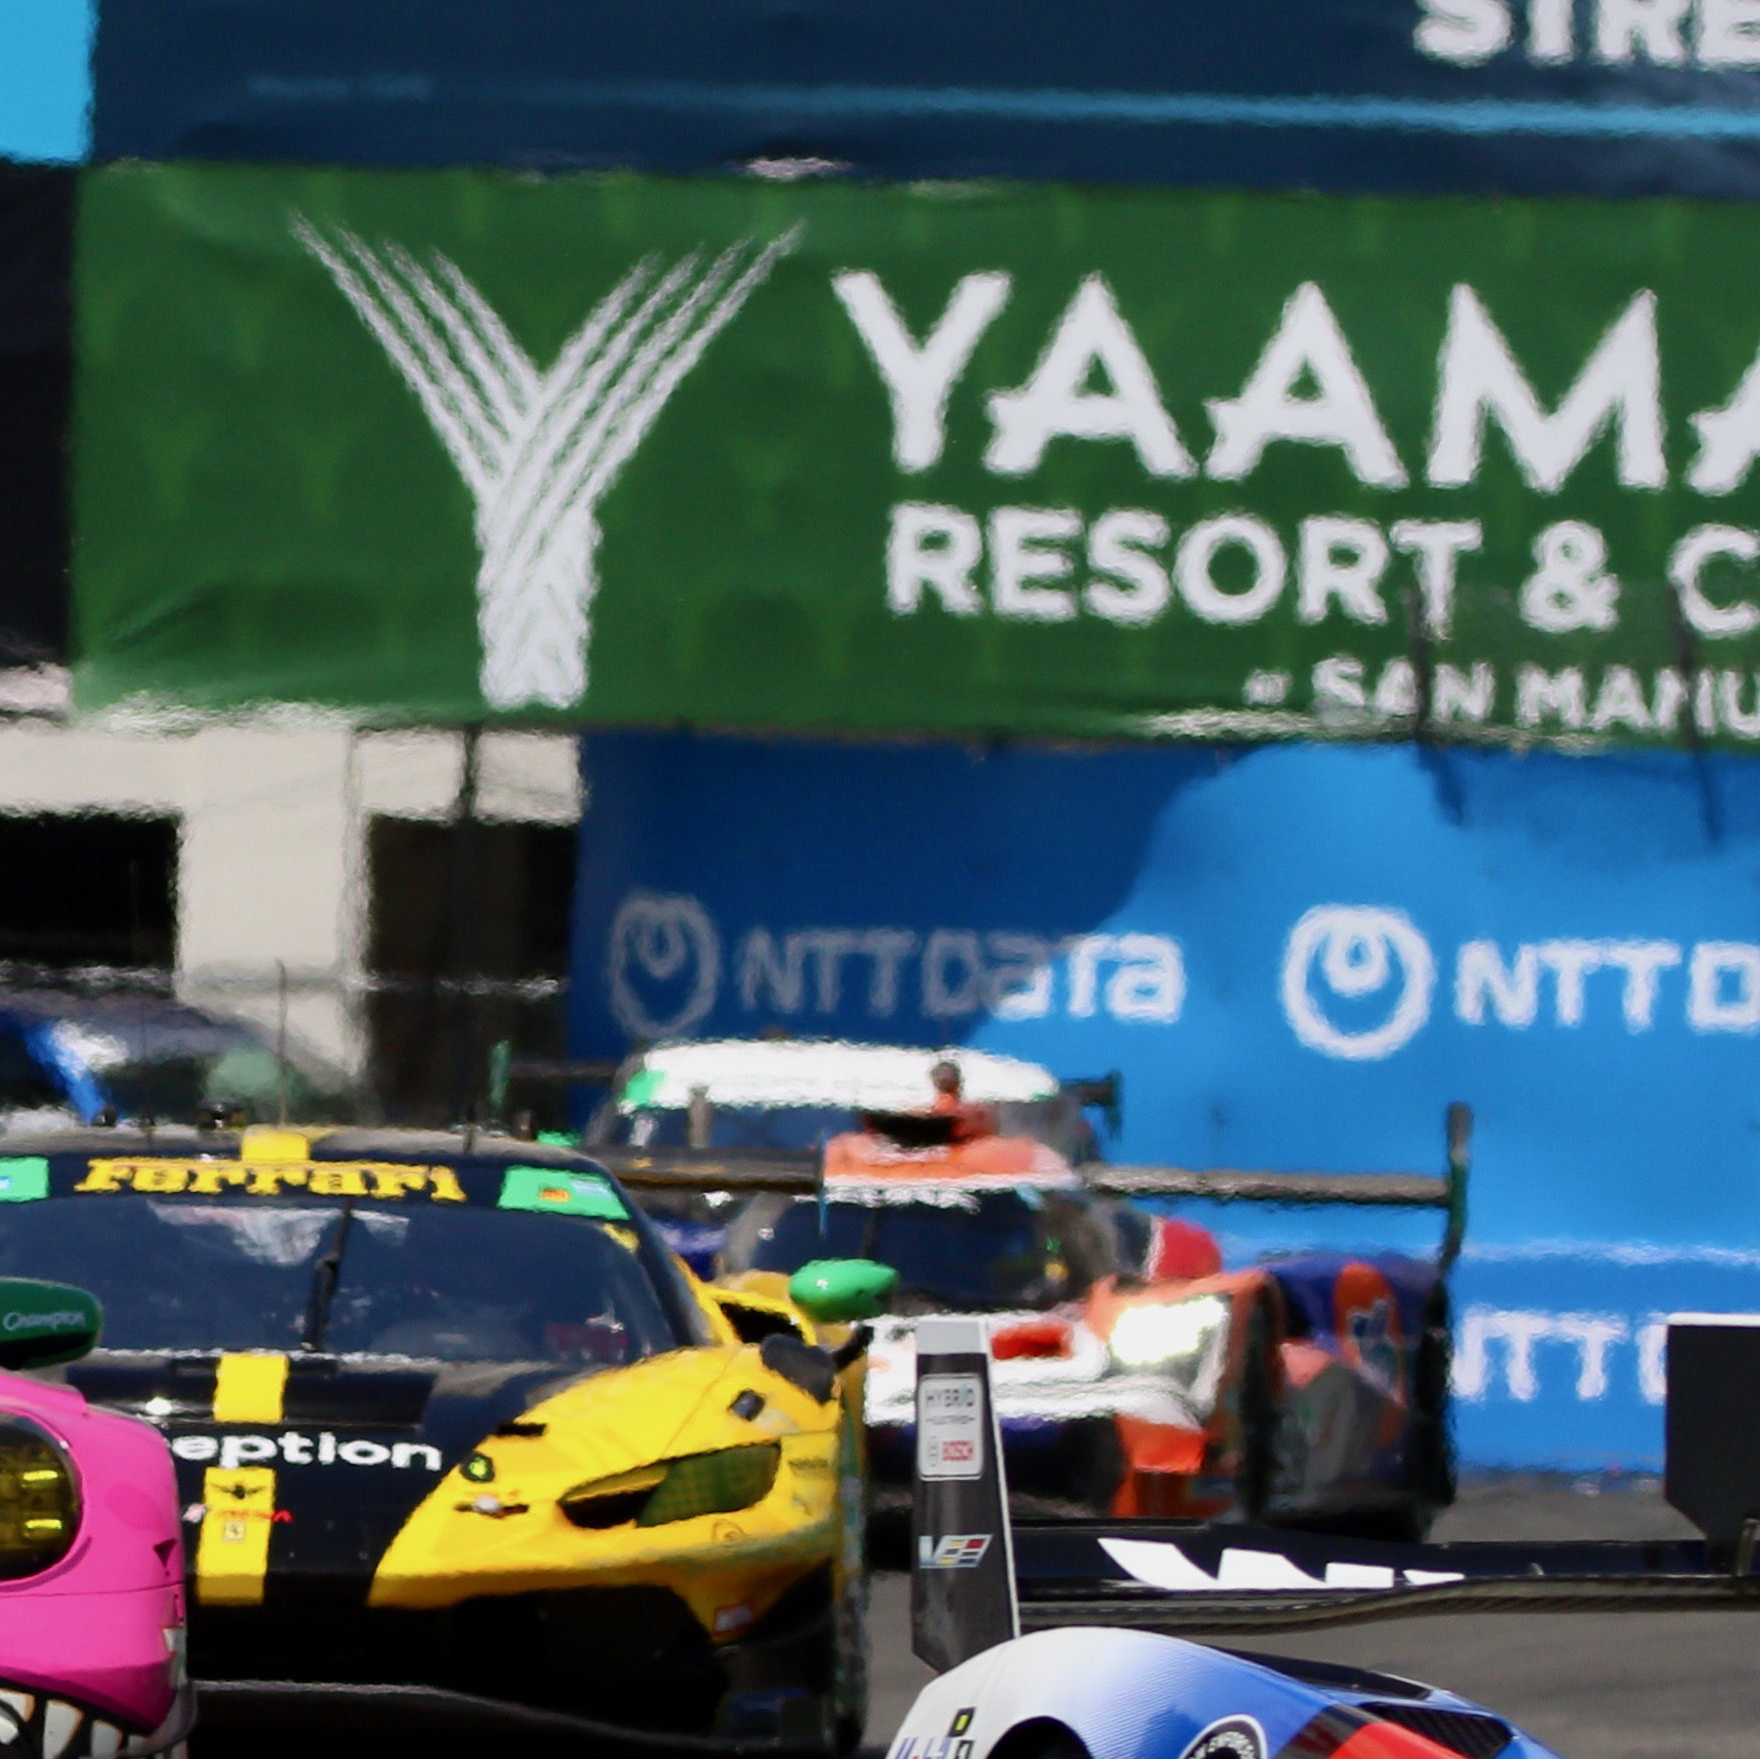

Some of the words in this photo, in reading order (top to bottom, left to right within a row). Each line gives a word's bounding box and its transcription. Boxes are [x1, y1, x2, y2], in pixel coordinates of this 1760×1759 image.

[884, 500, 1484, 642] RESORT
[1519, 518, 1621, 634] &
[1309, 655, 1497, 726] SAN
[1453, 936, 1683, 1036] NTT
[74, 1156, 469, 1202] Ferrari
[171, 1430, 443, 1472] eption
